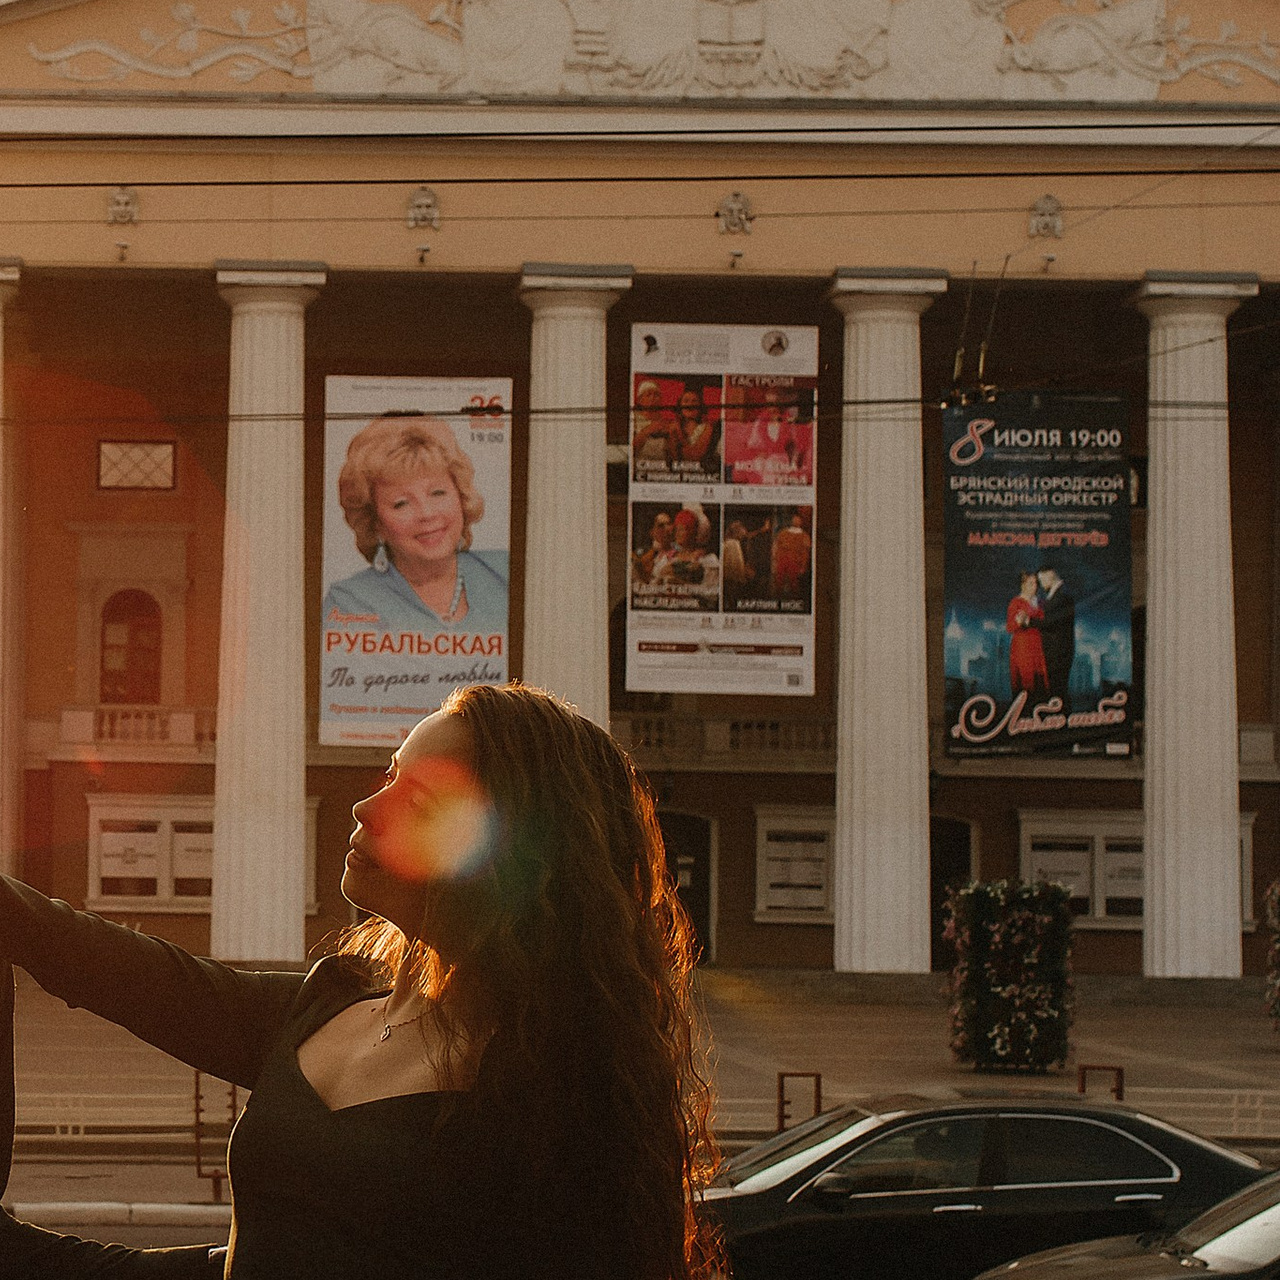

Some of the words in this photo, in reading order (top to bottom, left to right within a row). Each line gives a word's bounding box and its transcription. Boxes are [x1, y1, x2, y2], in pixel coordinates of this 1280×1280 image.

[949, 418, 995, 466] 8
[993, 428, 1062, 447] ИЮЛЯ
[1070, 428, 1121, 448] 19:00
[949, 474, 1030, 491] БРЯНСКИЙ
[1033, 473, 1124, 492] ГОРОДСКОЙ
[956, 490, 1049, 507] ЭСТРАДНЫЙ
[1051, 490, 1118, 506] ОРКЕСТР
[325, 631, 503, 657] РУБАЛЬСКАЯ
[327, 666, 357, 689] По
[363, 671, 431, 694] дороге
[437, 662, 502, 684] любви
